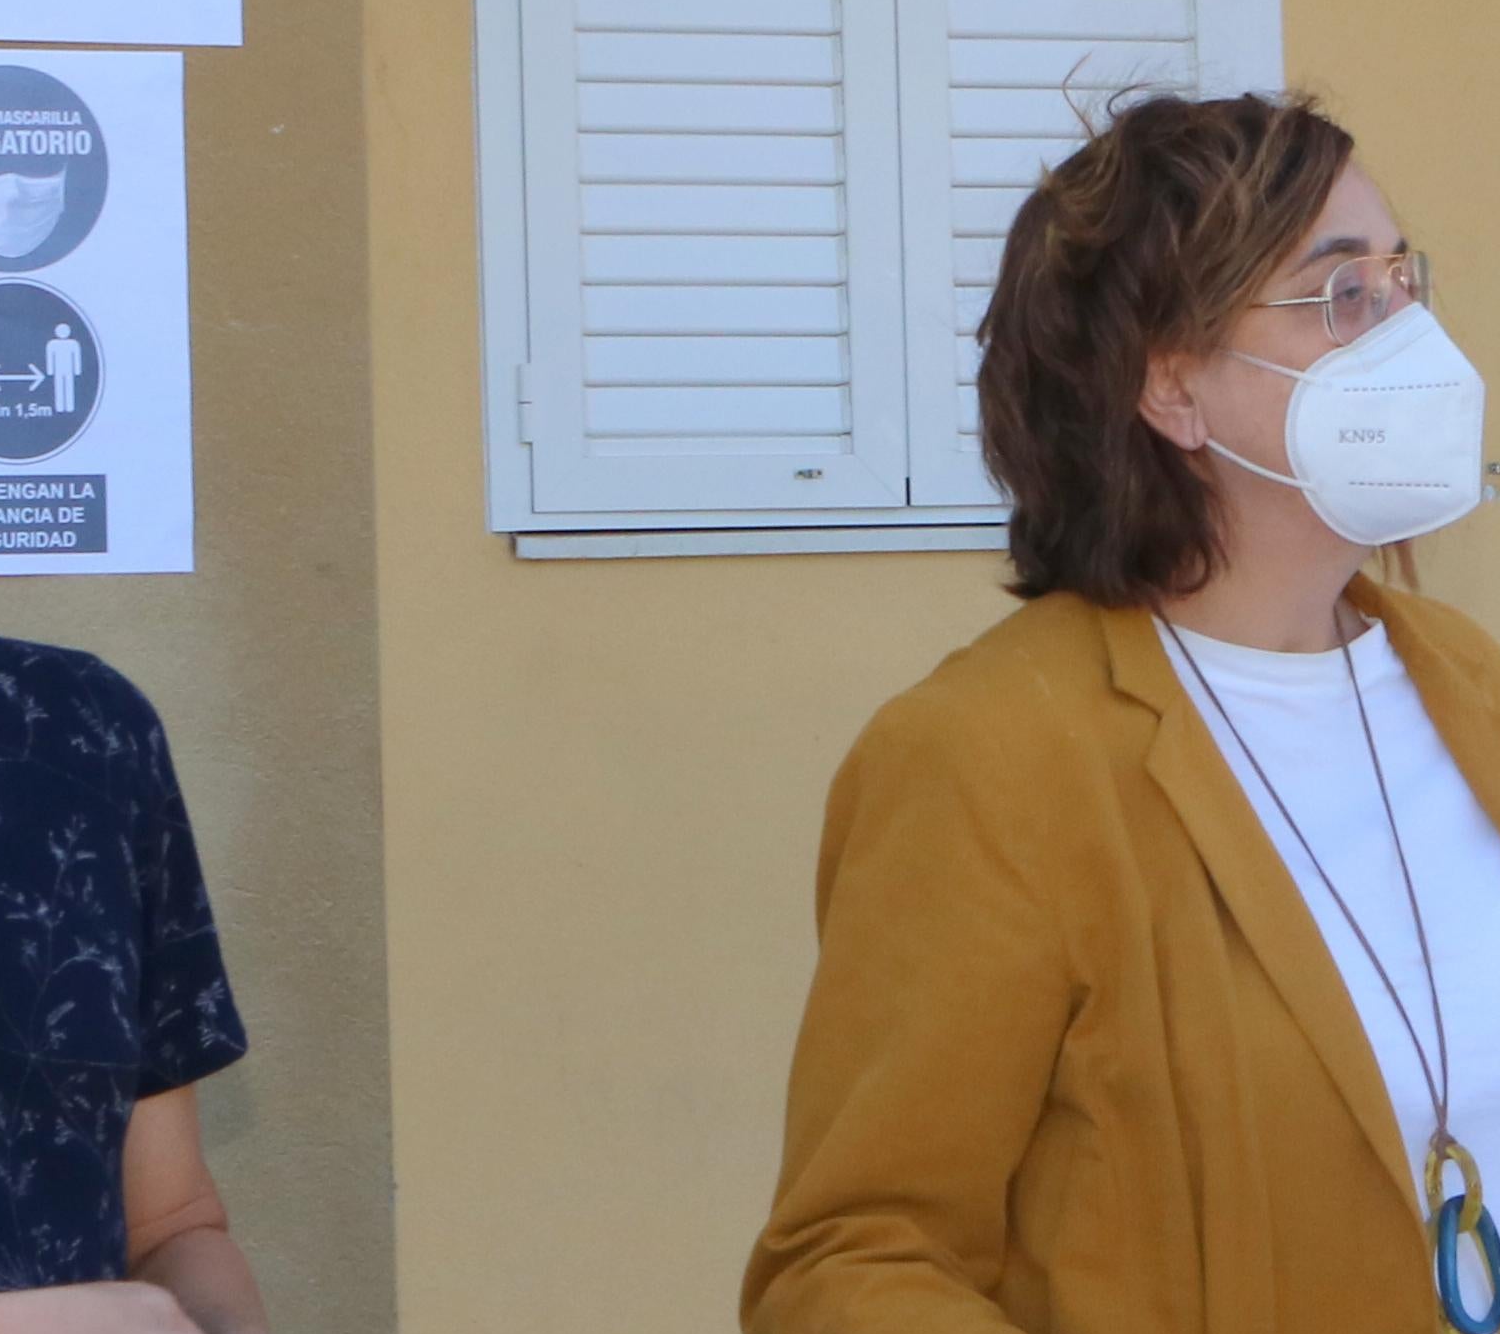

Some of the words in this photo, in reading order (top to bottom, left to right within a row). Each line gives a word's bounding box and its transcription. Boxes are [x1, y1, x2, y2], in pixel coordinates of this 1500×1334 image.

[15, 403, 53, 419] 1,5m
[1338, 429, 1385, 444] KN95
[68, 482, 95, 499] LA
[58, 507, 86, 524] DE
